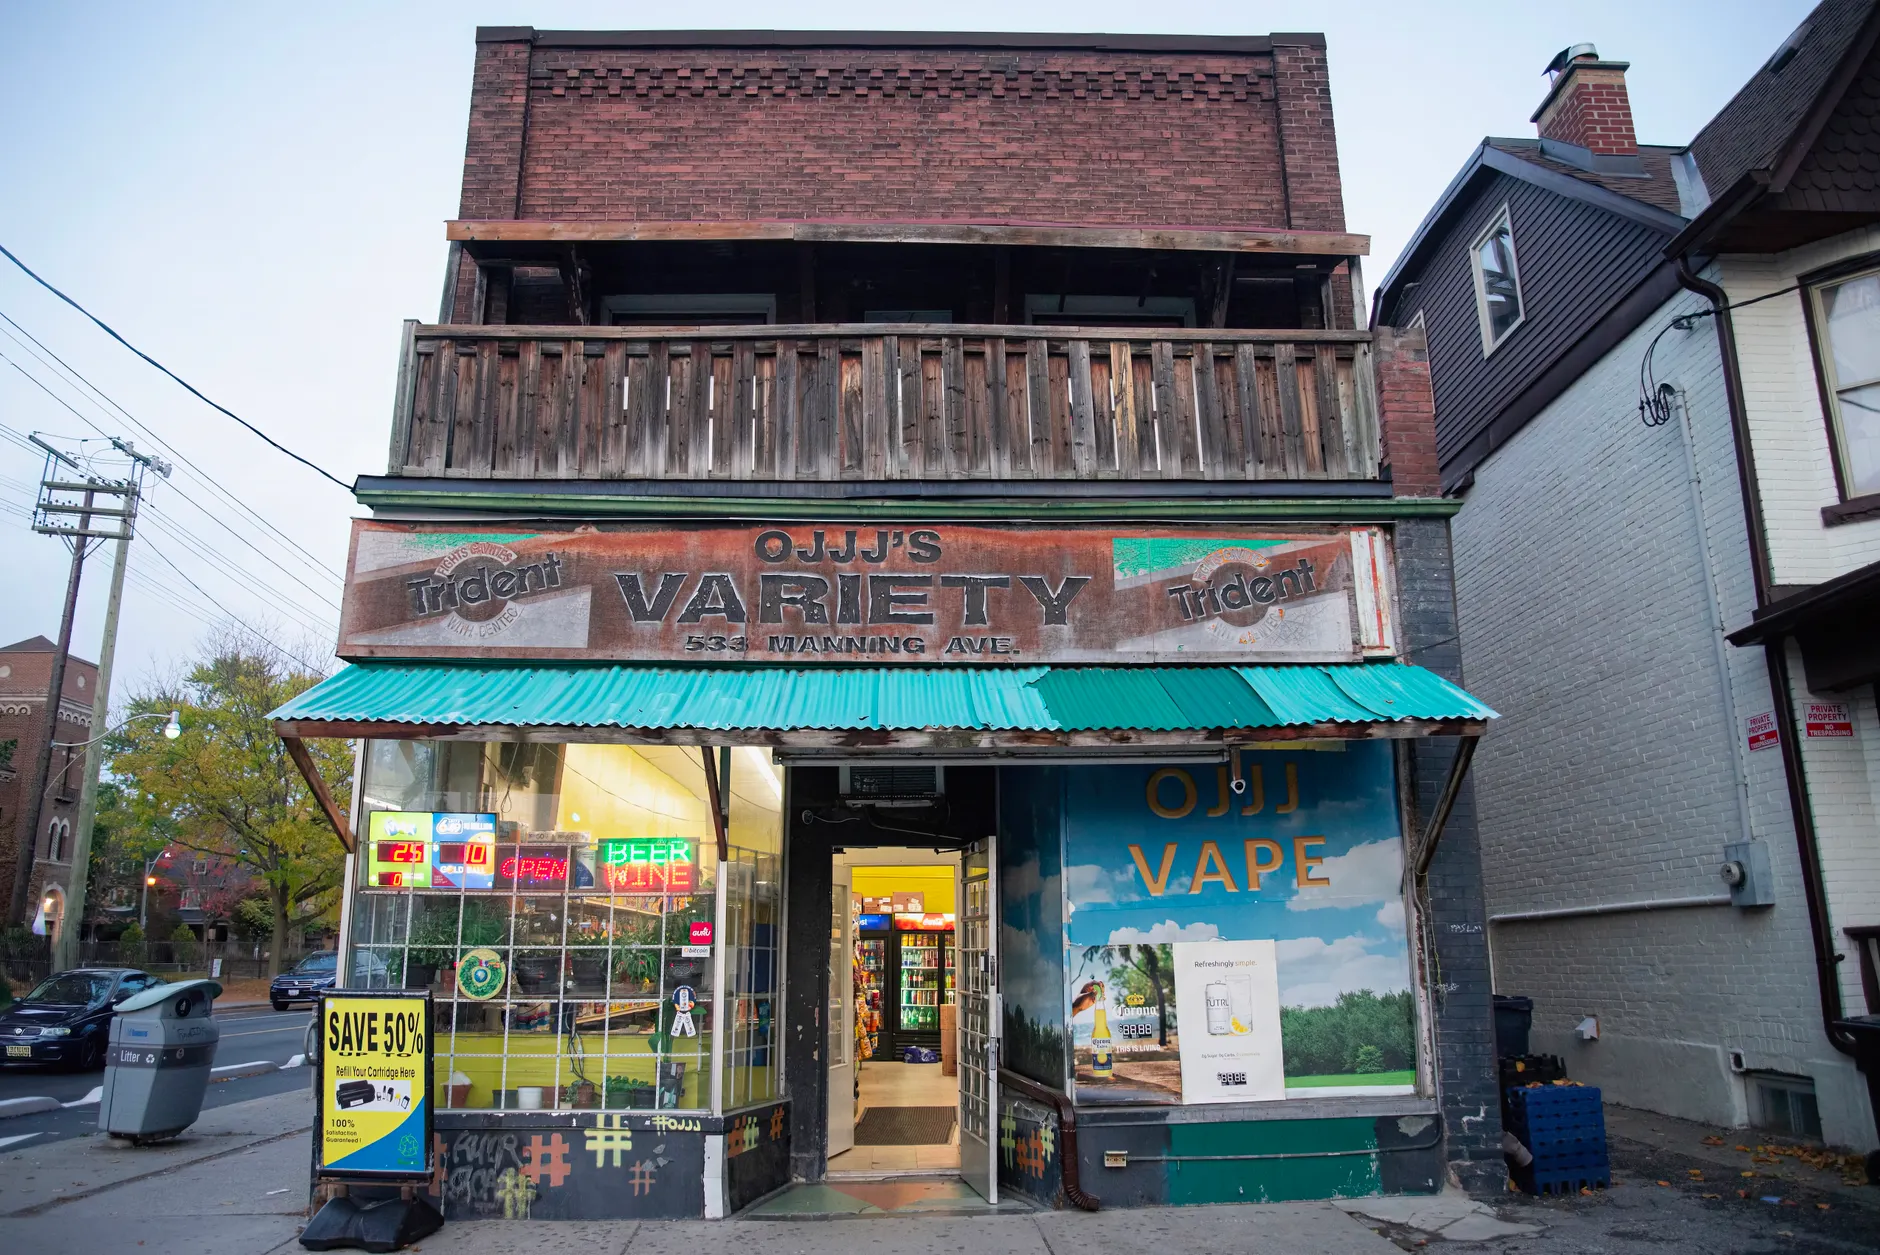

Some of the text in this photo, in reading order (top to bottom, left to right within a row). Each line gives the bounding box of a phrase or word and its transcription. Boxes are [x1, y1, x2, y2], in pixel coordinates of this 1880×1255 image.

[754, 529, 943, 564] OJJJ'S
[437, 547, 469, 577] FIGHTS
[406, 552, 562, 616] Trident
[1168, 558, 1318, 621] Trident
[614, 573, 1092, 626] VARIETY
[685, 635, 1021, 655] 533 MANNING AVE.
[1808, 713, 1847, 721] PROPERTY
[1811, 705, 1842, 713] PRIVATE
[1748, 722, 1774, 734] PROPERTY
[1750, 714, 1770, 726] PRIVATE
[1146, 761, 1299, 819] OJJJ
[393, 843, 422, 862] 25
[607, 841, 690, 864] BEER
[501, 857, 567, 879] OPEN
[606, 863, 689, 885] WINE
[1128, 835, 1331, 896] VAPE
[1194, 959, 1258, 968] Refreshingly simple.
[1112, 1004, 1160, 1019] Corona
[329, 1011, 424, 1054] SAVE 50%
[120, 1050, 141, 1063] Litter
[1116, 1045, 1131, 1053] THIS
[1140, 1044, 1161, 1052] LIVING
[336, 1066, 415, 1080] Refill Your Cartridge Here
[331, 1119, 355, 1128] 100%
